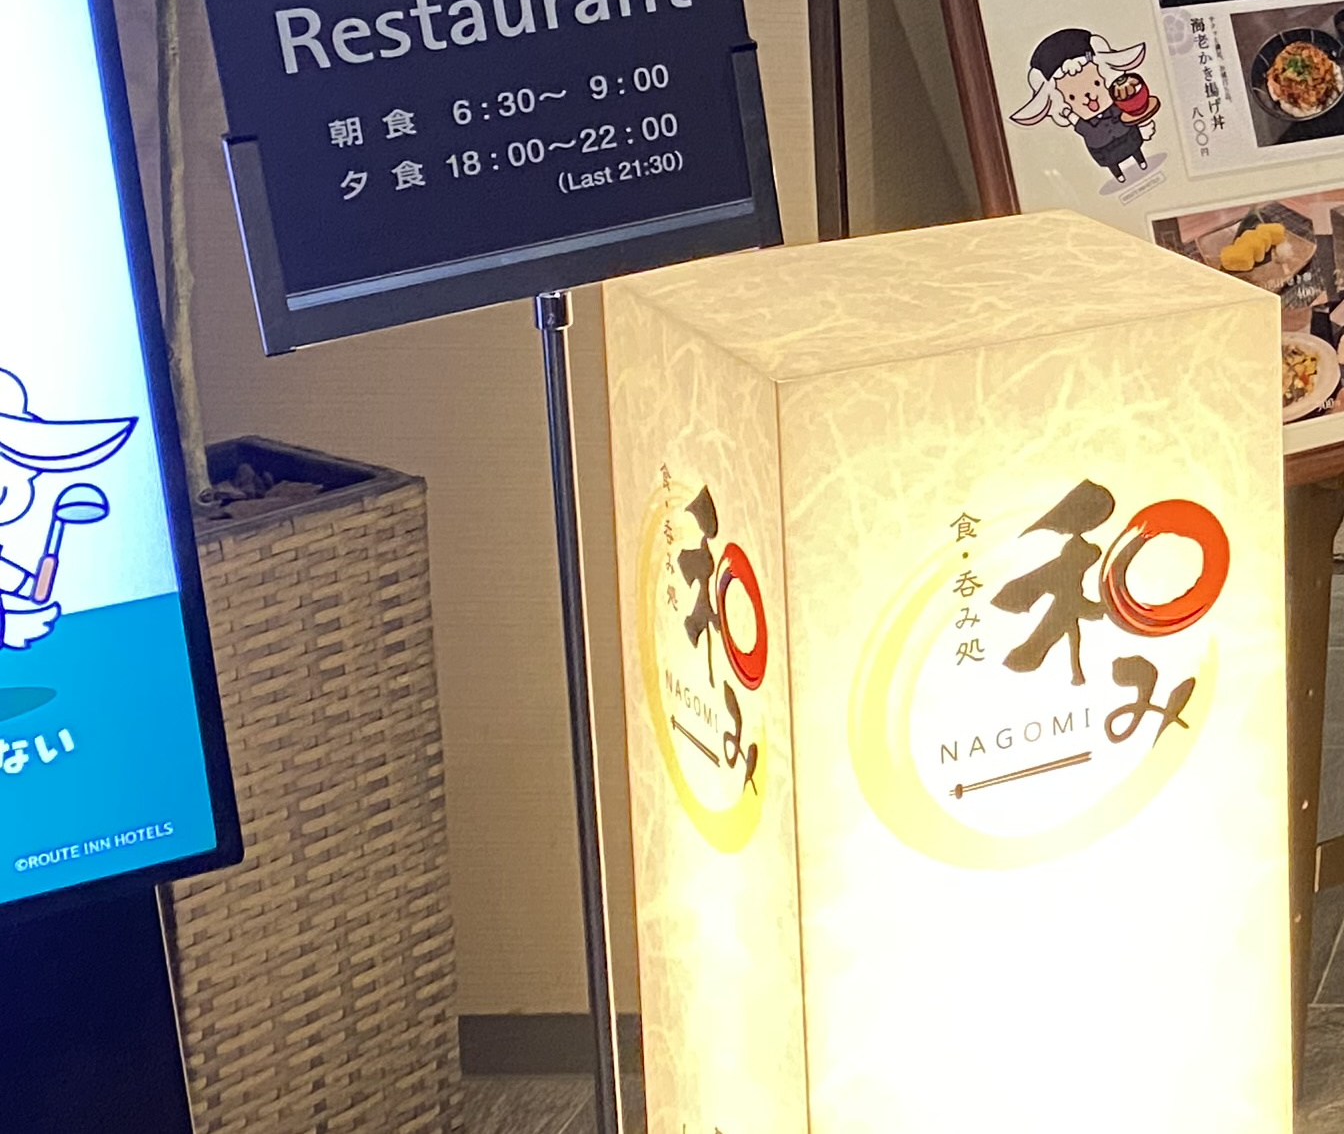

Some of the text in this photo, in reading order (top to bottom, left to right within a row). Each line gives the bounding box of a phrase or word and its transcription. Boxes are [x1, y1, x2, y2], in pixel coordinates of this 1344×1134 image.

[328, 107, 418, 148] 朝食
[340, 160, 427, 201] 夕食
[557, 150, 685, 195] (Last 21:30)
[989, 478, 1232, 749] 和み
[665, 669, 719, 734] NAGOMI
[939, 706, 1093, 765] NAGOMI
[84, 836, 112, 856] INN
[114, 820, 174, 848] HOTELS
